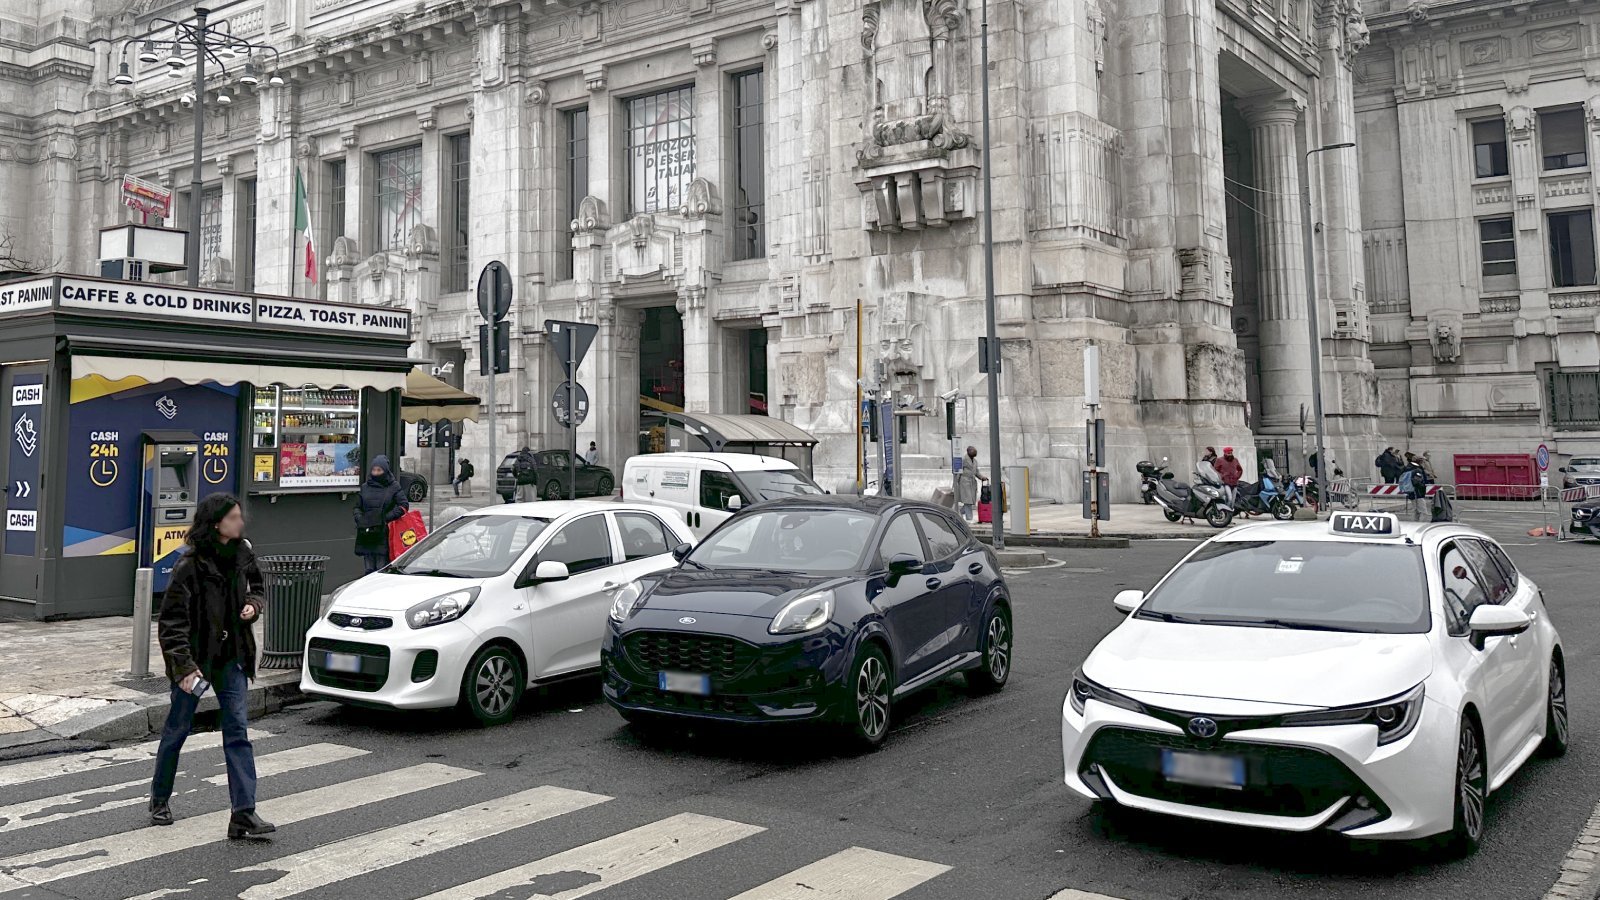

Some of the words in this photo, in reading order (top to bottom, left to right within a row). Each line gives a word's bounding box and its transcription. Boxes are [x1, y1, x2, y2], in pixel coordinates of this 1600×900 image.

[0, 291, 15, 306] ST,
[18, 286, 52, 303] PANINI
[62, 286, 119, 303] CAFFE
[125, 291, 137, 305] &
[143, 293, 188, 309] COLD
[192, 298, 251, 315] DRINKS
[258, 304, 306, 322] PIZZA,
[310, 309, 359, 326] TOAST,
[362, 314, 407, 329] PANINI
[15, 388, 40, 401] CASH
[90, 431, 119, 441] CASH
[203, 432, 229, 441] CASH
[90, 443, 119, 457] 24h
[203, 443, 229, 456] 24h
[10, 513, 34, 526] CASH
[1341, 515, 1384, 531] TAXI
[164, 530, 186, 540] ATM
